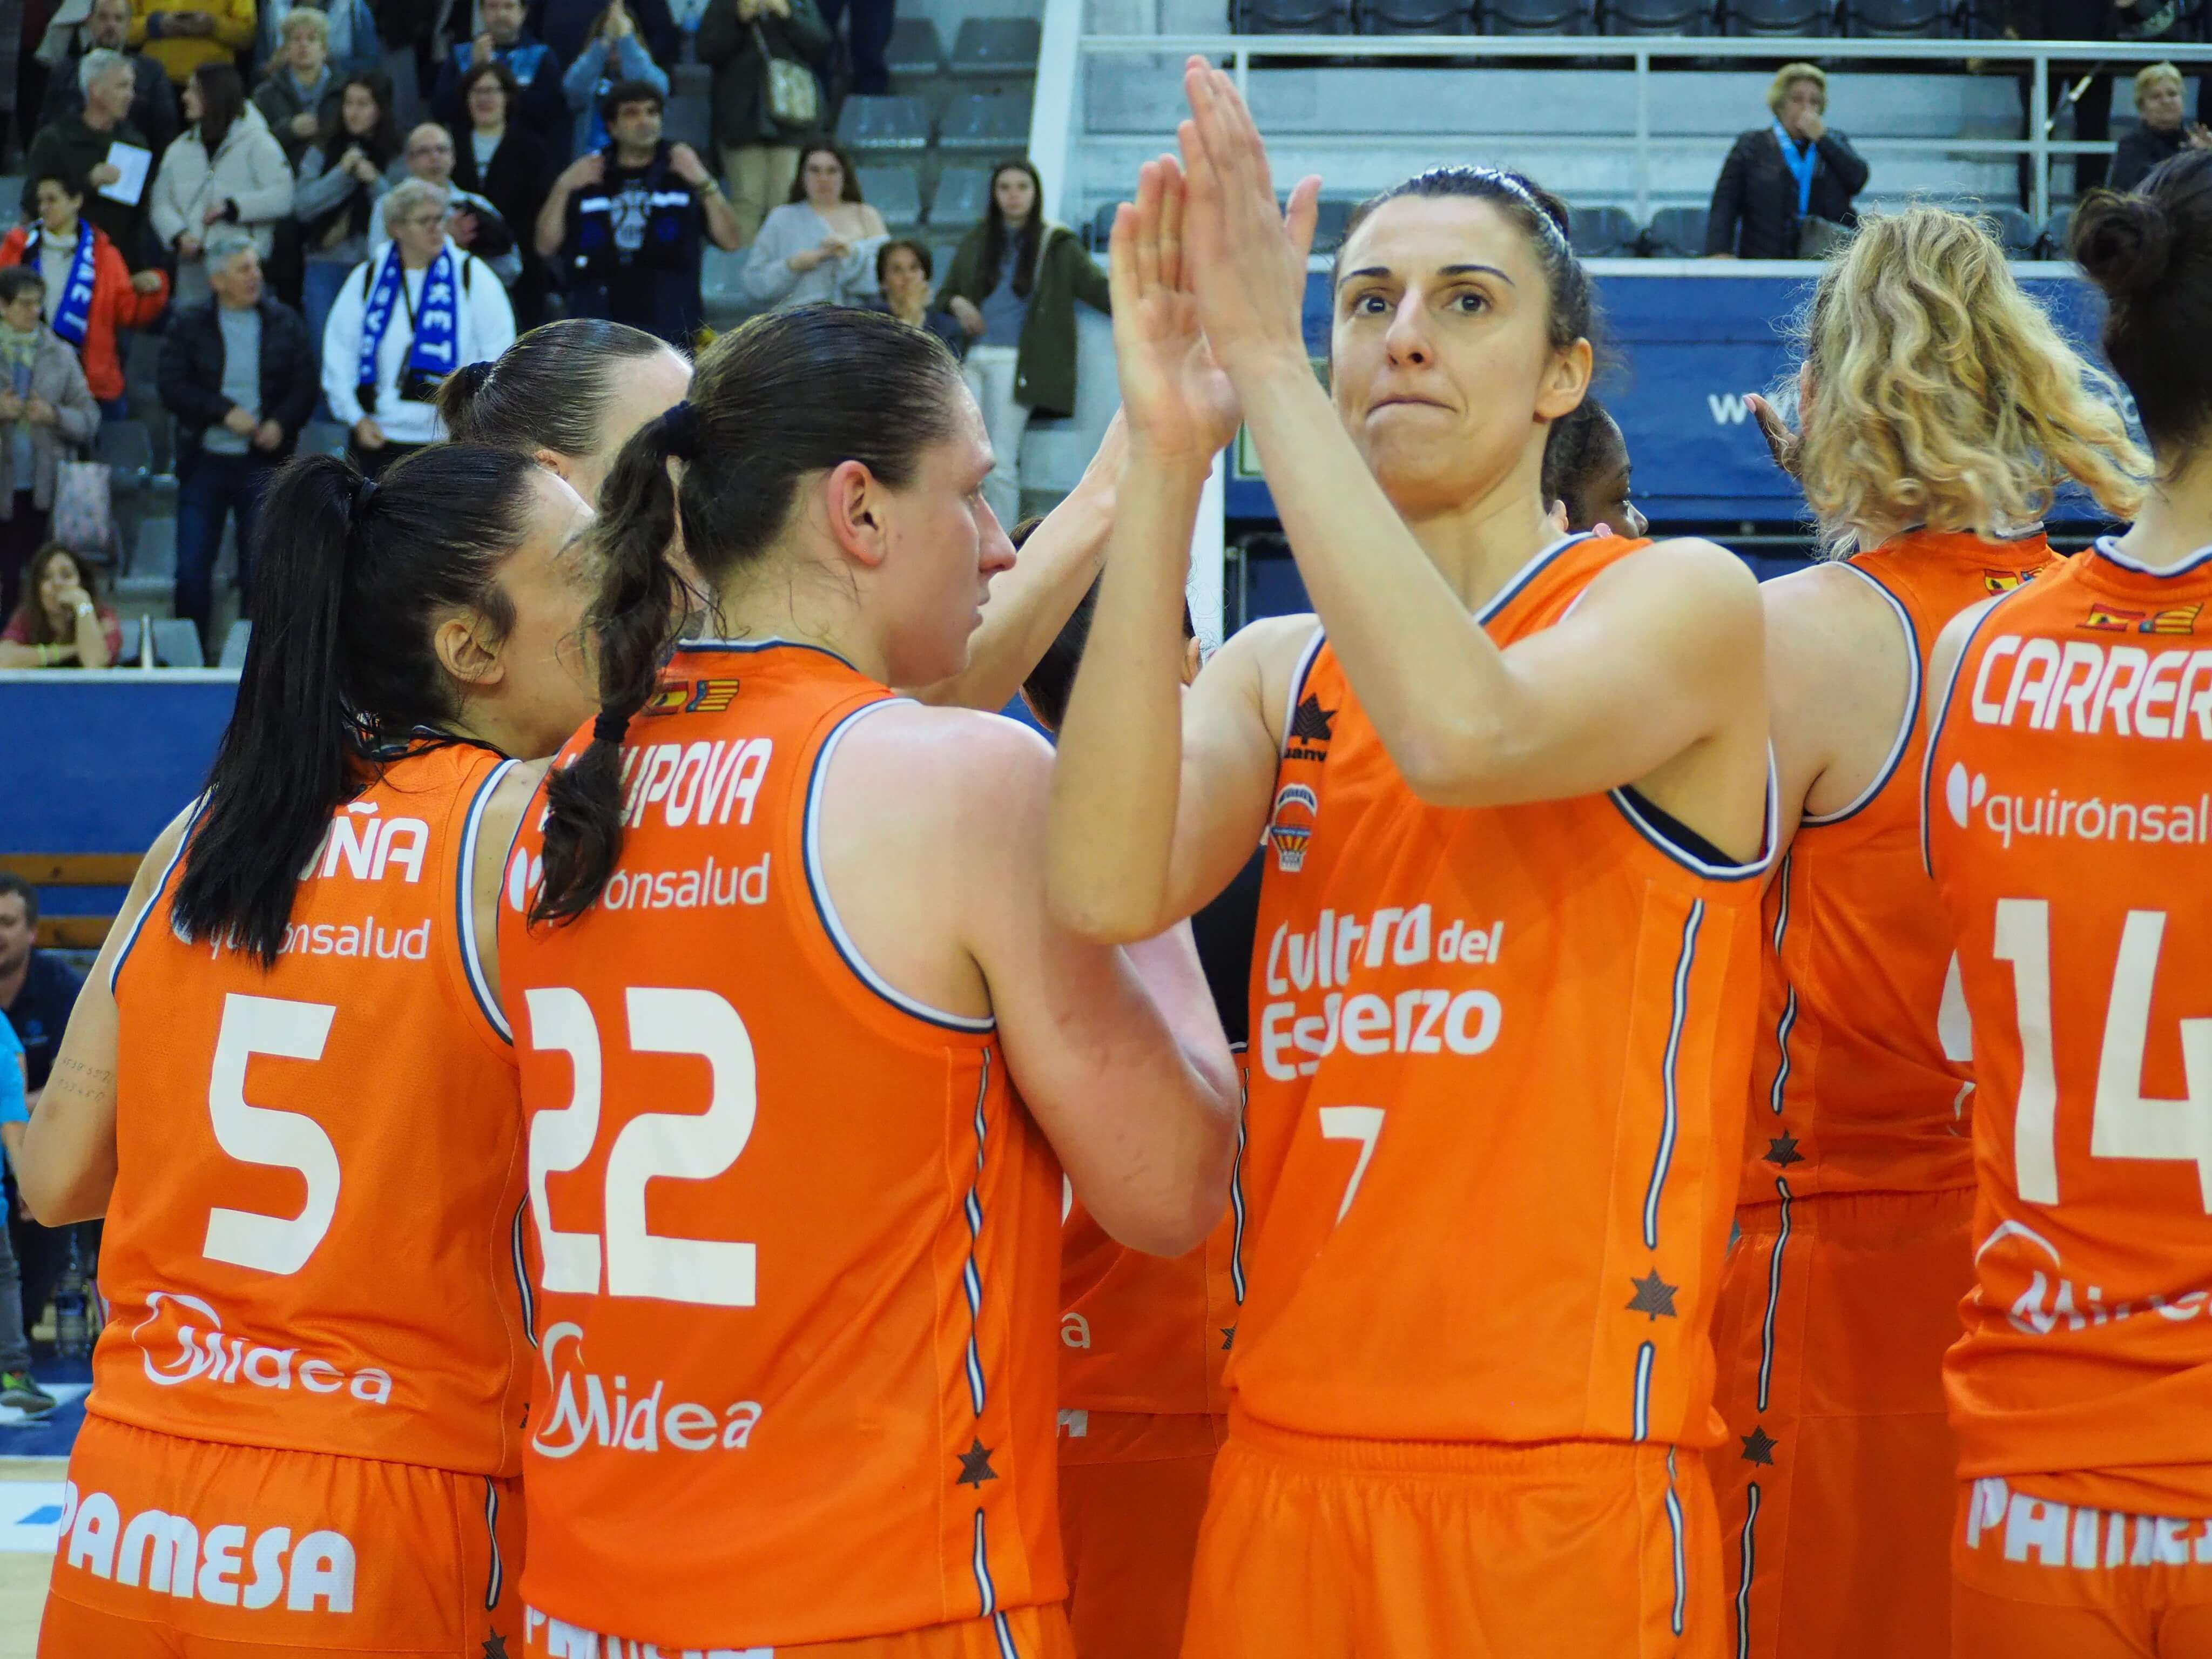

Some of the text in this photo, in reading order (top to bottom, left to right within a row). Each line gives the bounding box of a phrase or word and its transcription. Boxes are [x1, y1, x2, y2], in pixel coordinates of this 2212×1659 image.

[1972, 635, 2212, 740] CARRER
[299, 801, 429, 882] ÑA
[551, 738, 773, 832] UPOVA
[1986, 789, 2210, 849] quirónsal
[1267, 903, 1505, 996] Cultra del
[1993, 898, 2212, 1216] 14
[203, 993, 341, 1275] 5
[525, 987, 757, 1307] 22
[1318, 1105, 1386, 1227] 7
[532, 1321, 763, 1458] Midea
